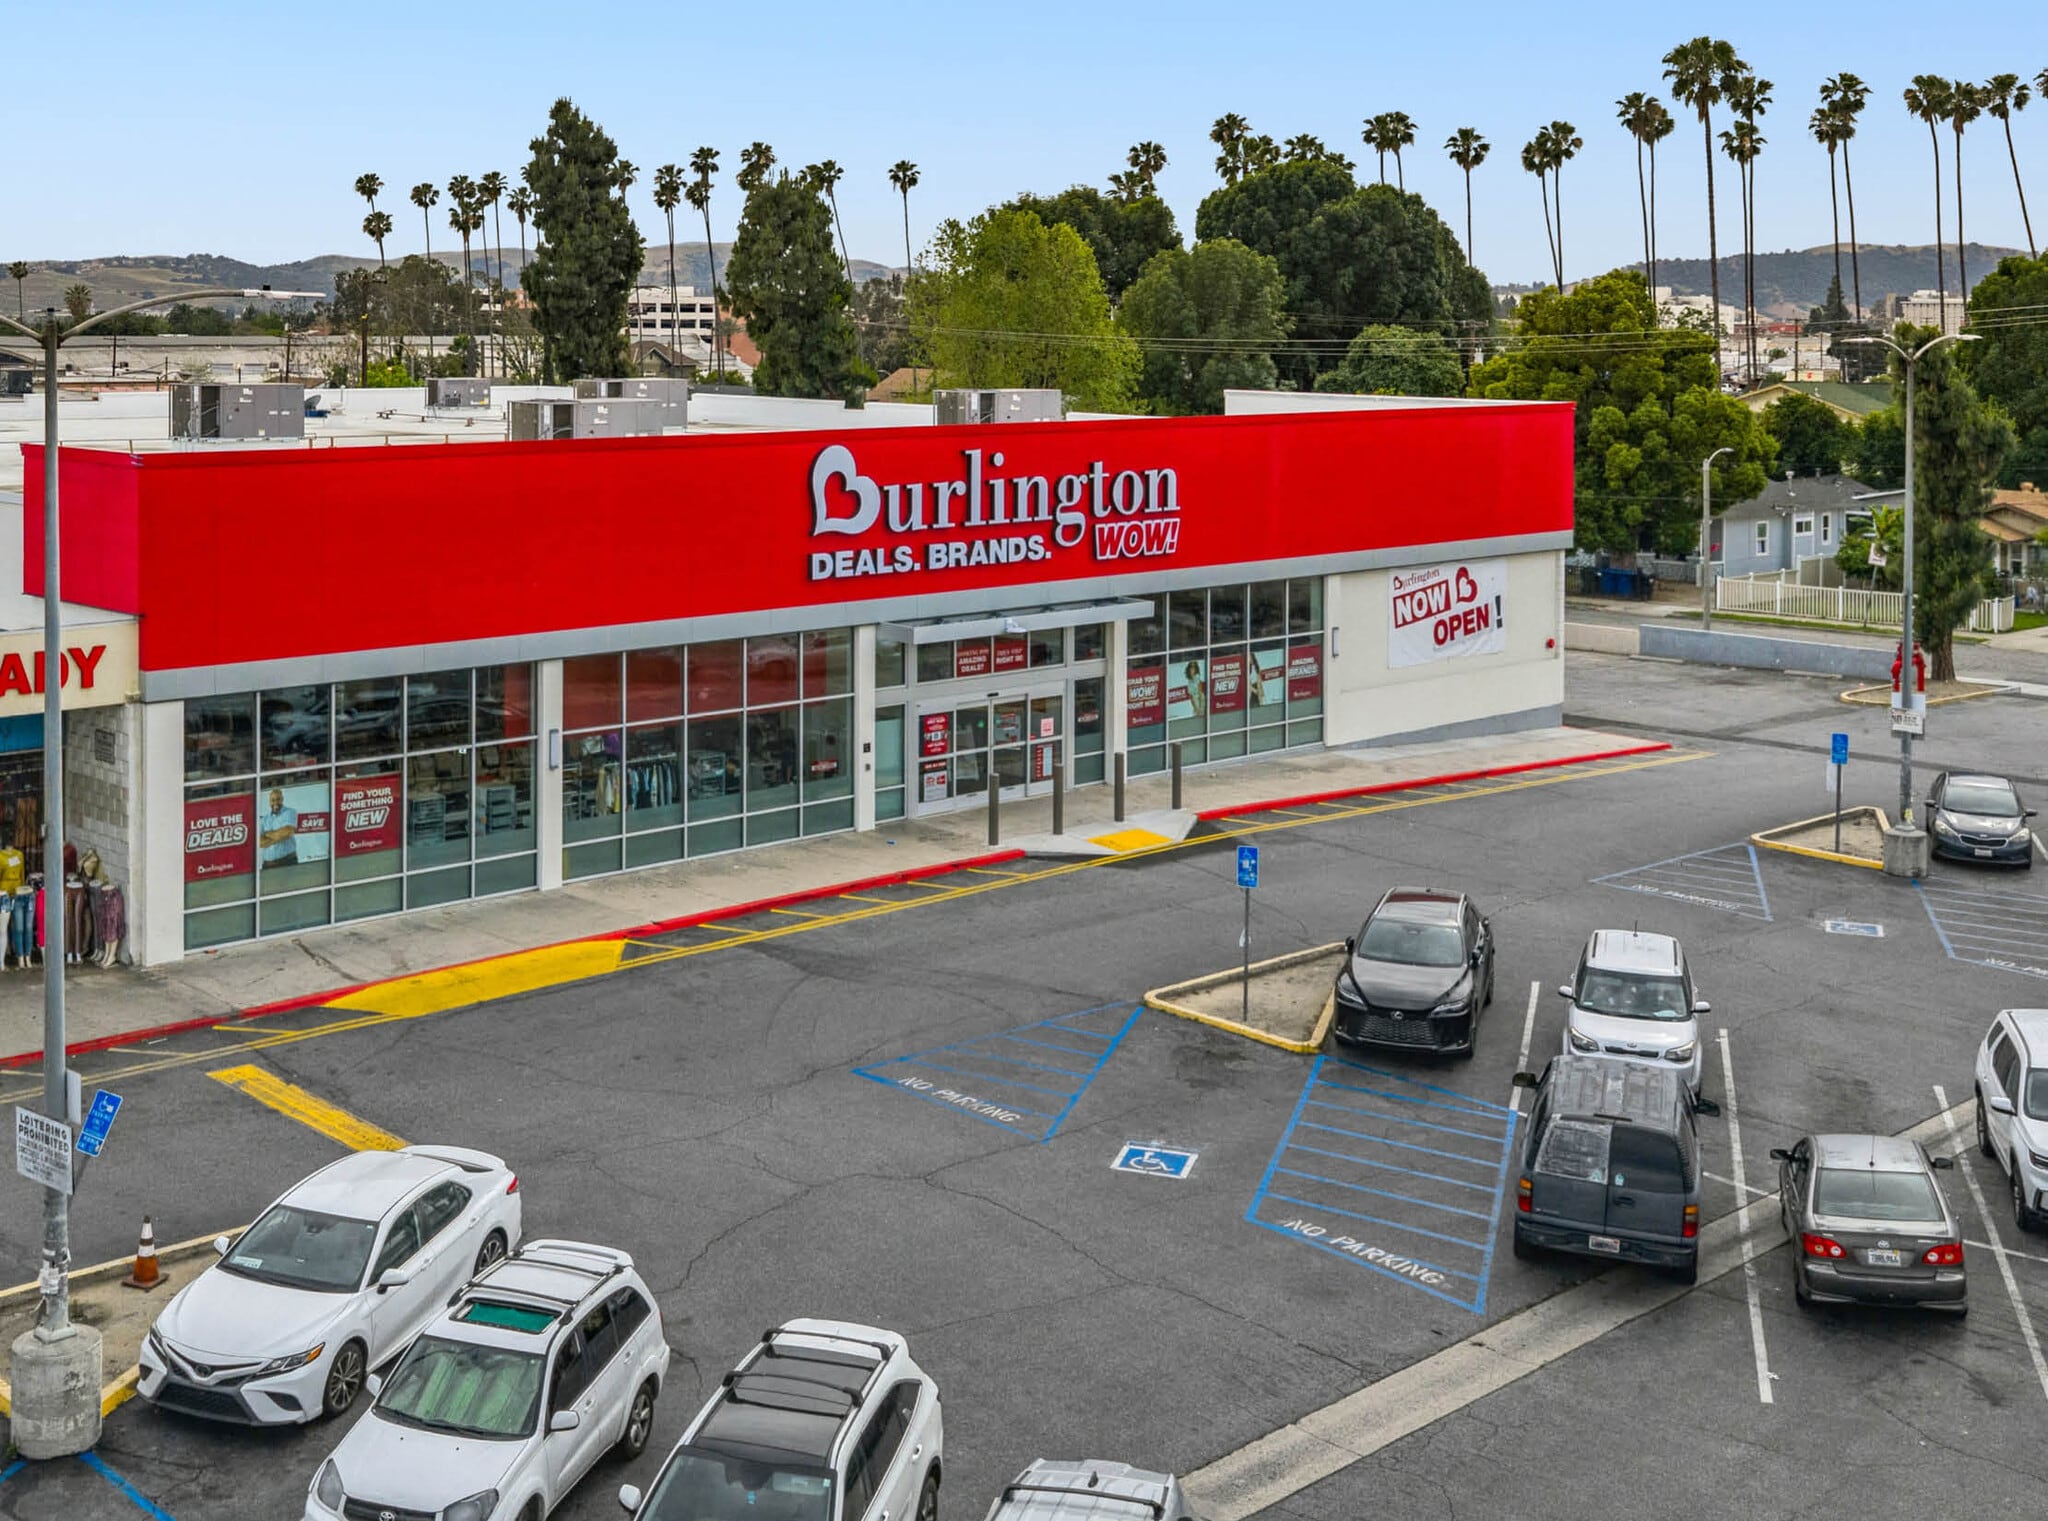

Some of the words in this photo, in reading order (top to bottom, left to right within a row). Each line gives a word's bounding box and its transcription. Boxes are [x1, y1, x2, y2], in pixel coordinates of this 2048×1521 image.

[812, 444, 1182, 547] Burlington
[811, 547, 921, 580] DEALS.
[928, 535, 1052, 570] BRANDS.
[1096, 518, 1181, 560] WOW!
[1393, 568, 1440, 590] Burlington
[1395, 582, 1448, 628] NOW
[1215, 679, 1237, 693] NEW
[340, 796, 394, 812] SOMETHING
[343, 792, 364, 802] FIND
[366, 787, 392, 798] YOUR
[190, 817, 219, 830] LOVE
[220, 813, 243, 826] THE
[301, 818, 325, 829] SAVE
[348, 810, 385, 828] NEW
[187, 827, 245, 849] DEALS
[898, 1077, 933, 1090] NO
[931, 1088, 1021, 1122] PARKING
[20, 1113, 67, 1140] LOITERING
[19, 1124, 69, 1153] PROHIBITED
[1283, 1219, 1327, 1237] NO
[1329, 1235, 1446, 1284] PARKING
